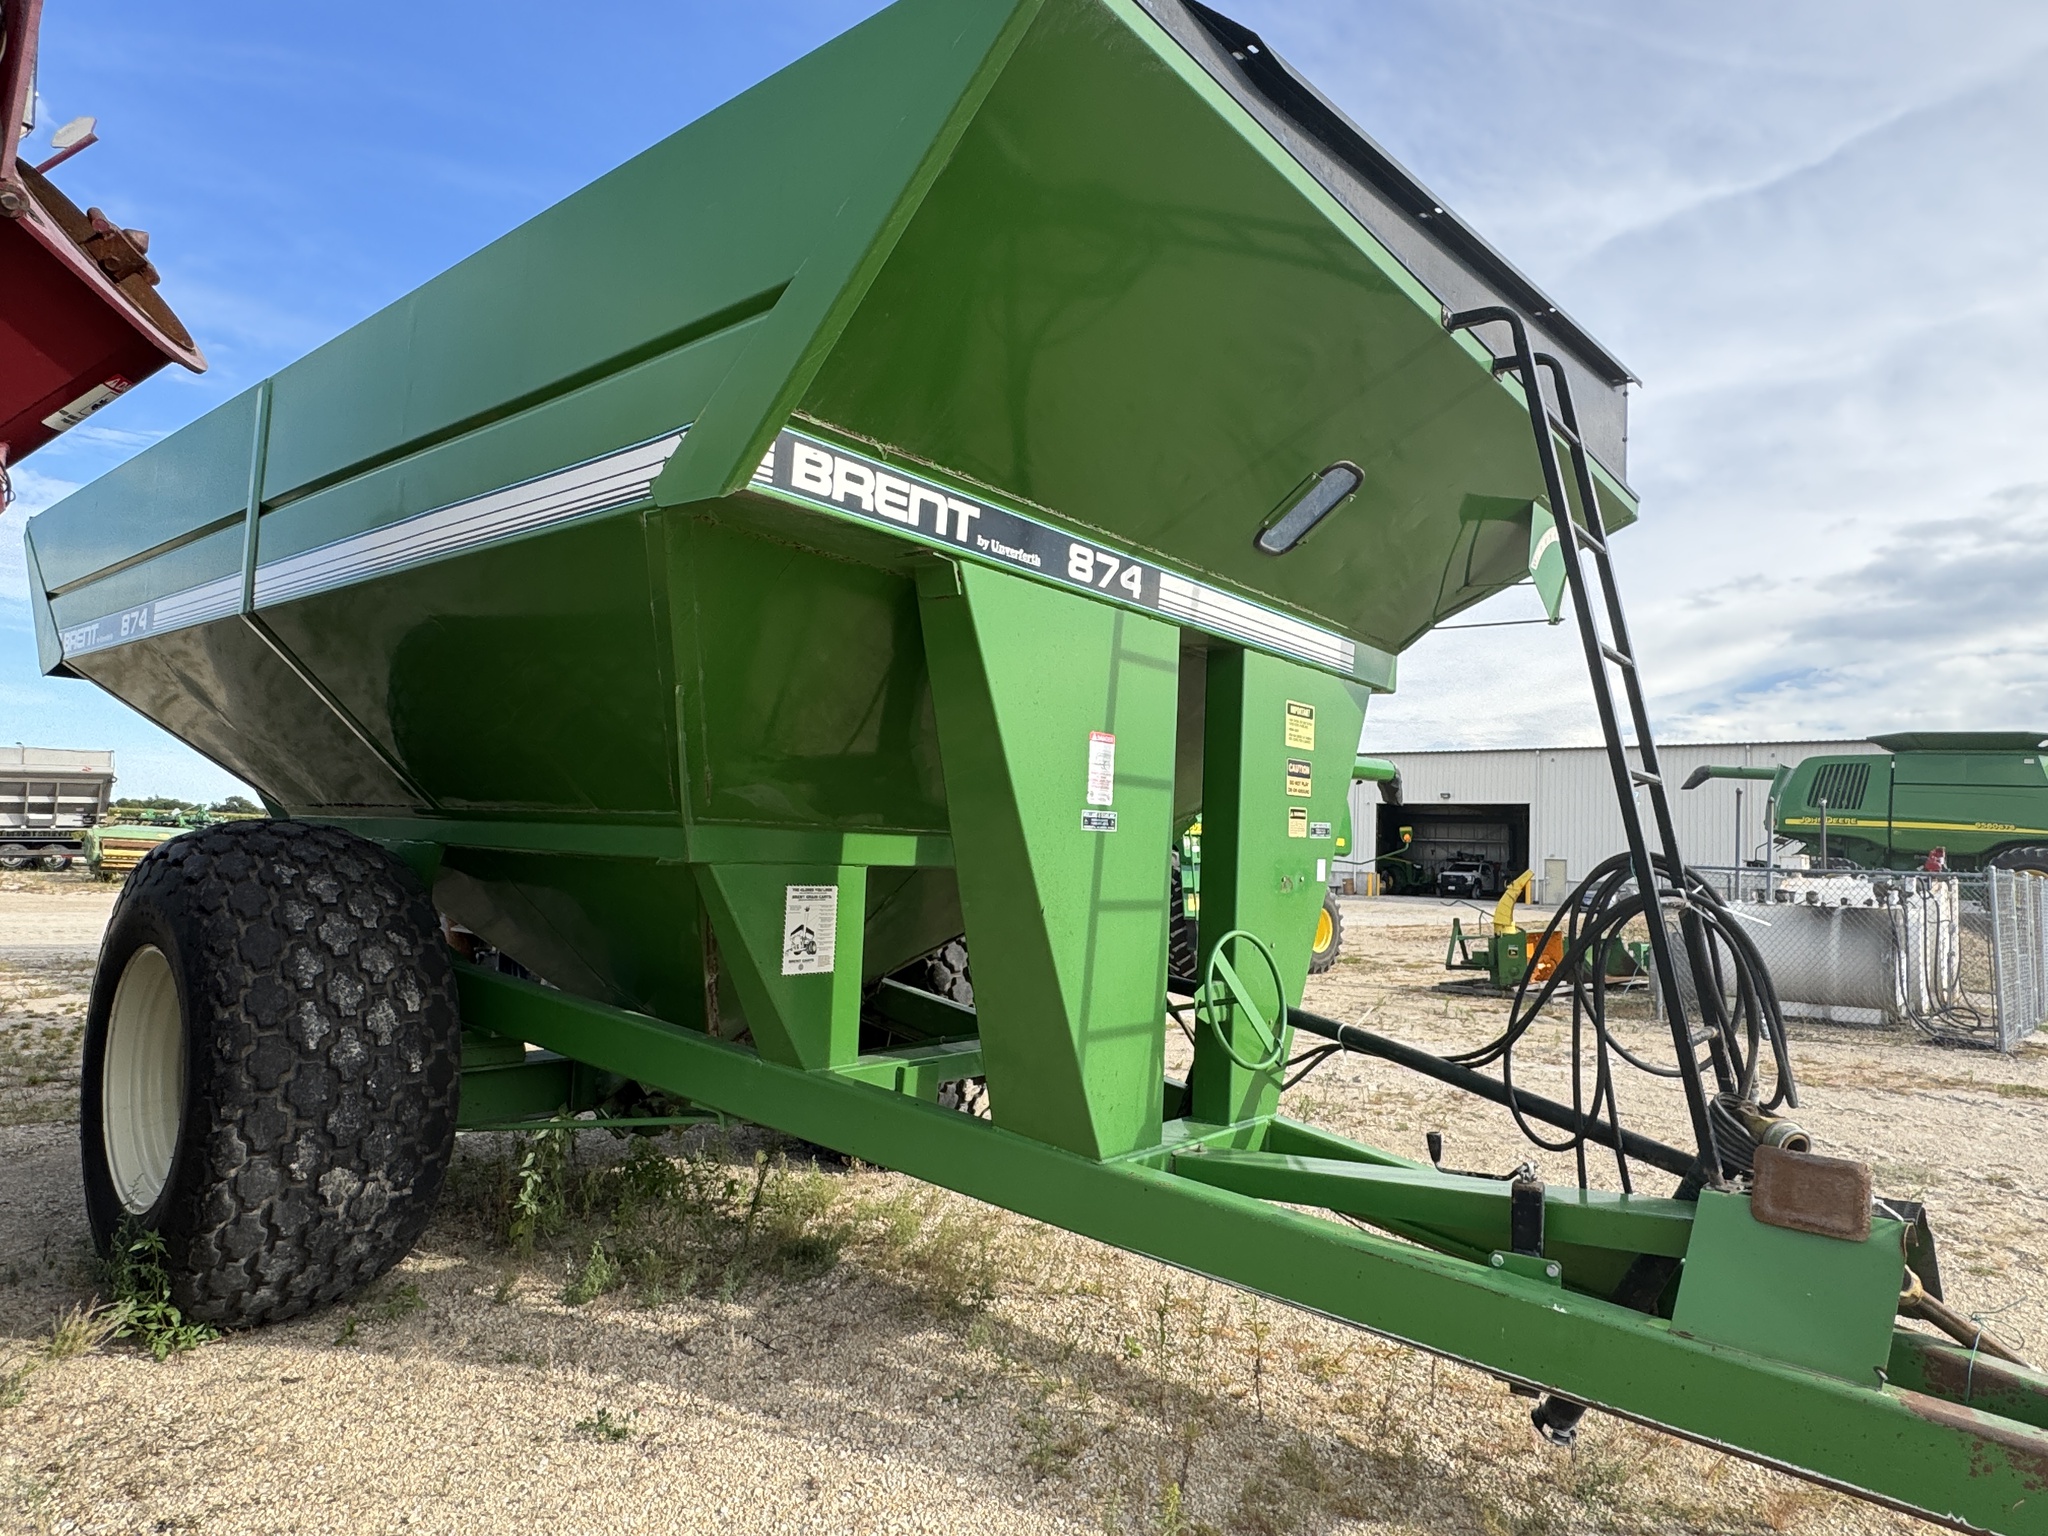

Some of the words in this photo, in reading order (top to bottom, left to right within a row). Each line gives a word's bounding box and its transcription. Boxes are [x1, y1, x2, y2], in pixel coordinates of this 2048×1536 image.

[791, 441, 981, 543] BRENT
[976, 534, 991, 551] by
[990, 538, 1042, 568] Unverferth
[1068, 542, 1142, 600] 874
[63, 622, 100, 653] BRENT
[120, 607, 149, 637] 874
[1825, 816, 1858, 825] DEERE
